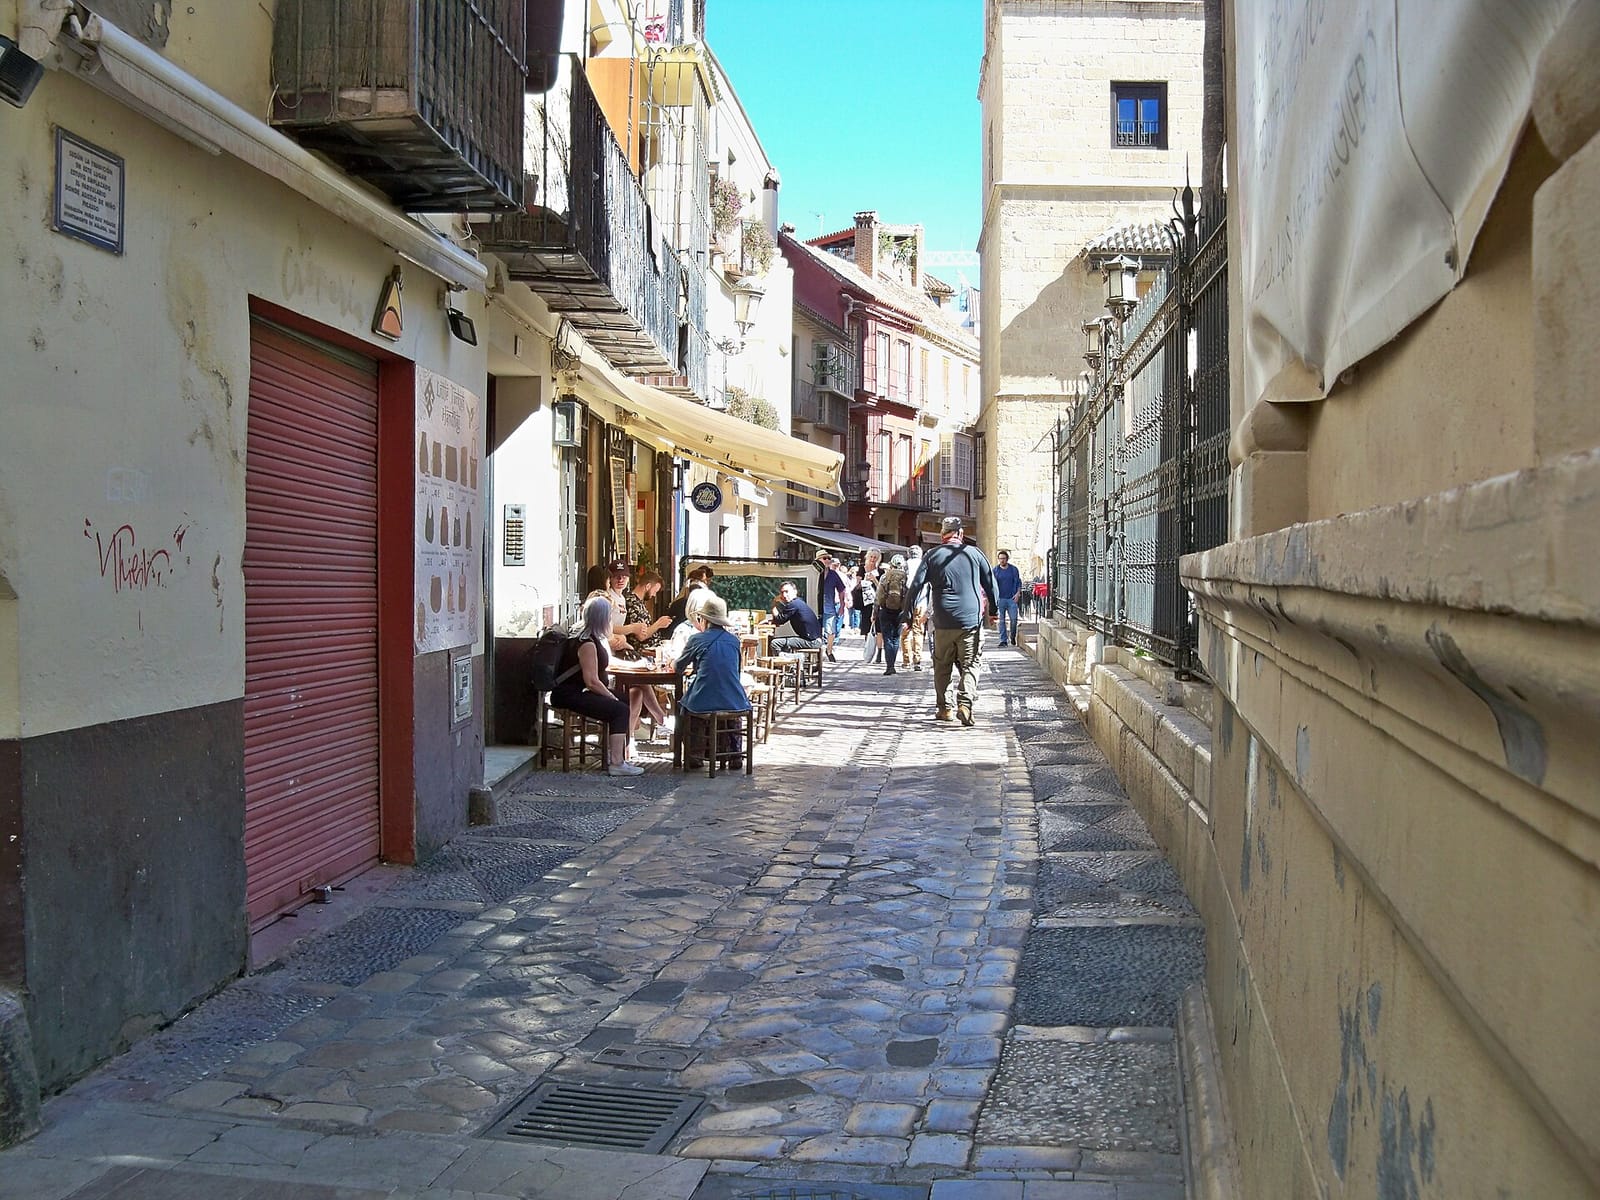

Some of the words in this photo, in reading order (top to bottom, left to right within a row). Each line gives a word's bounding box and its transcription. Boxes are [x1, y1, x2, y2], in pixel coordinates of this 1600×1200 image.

[70, 168, 86, 181] ESTUVO
[87, 176, 112, 192] EMPLAZADO
[83, 165, 92, 175] ESTE
[93, 170, 107, 181] LUGAR
[64, 183, 80, 196] DONDE
[98, 198, 104, 207] DE
[75, 179, 81, 188] EL
[81, 182, 106, 199] PARVULARIO
[82, 200, 99, 212] PICASSO
